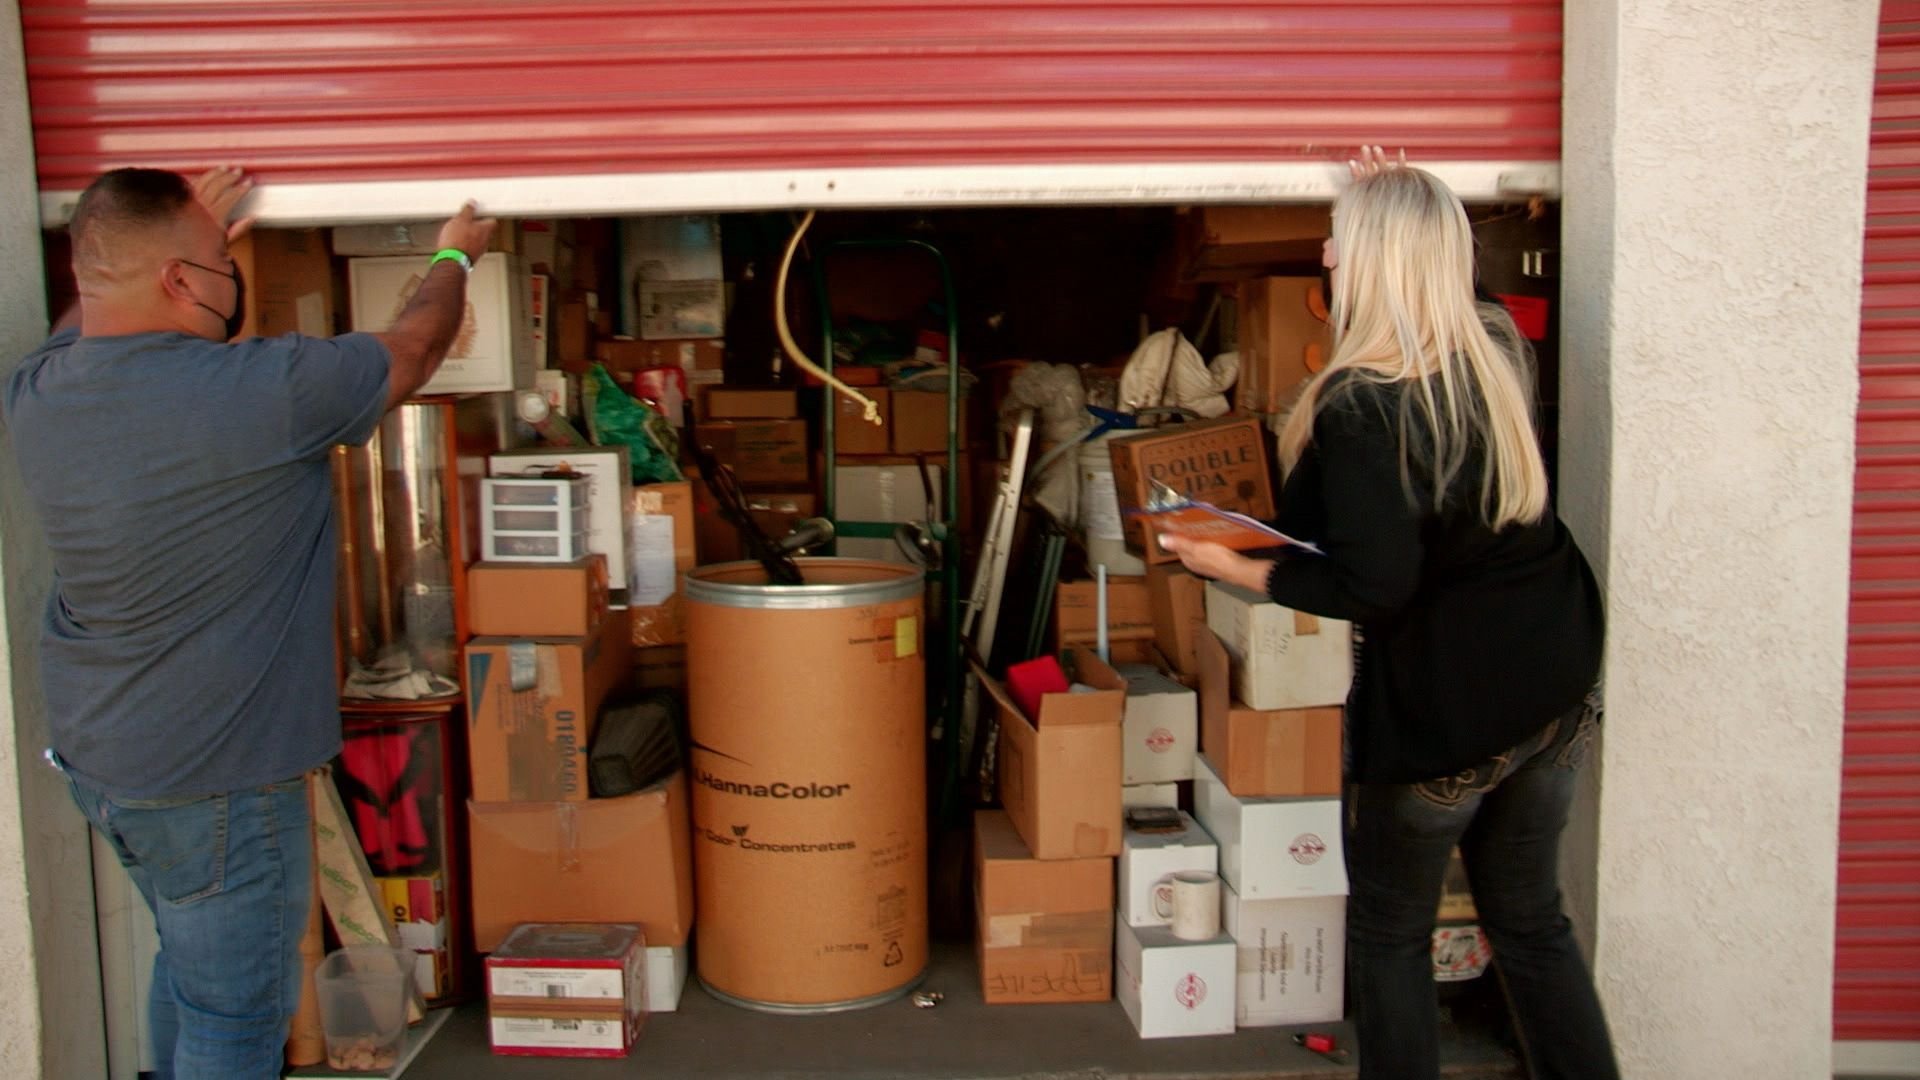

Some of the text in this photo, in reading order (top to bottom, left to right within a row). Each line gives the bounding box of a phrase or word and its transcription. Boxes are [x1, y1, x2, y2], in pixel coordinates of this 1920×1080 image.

[1149, 443, 1256, 480] DOUBLE
[1185, 472, 1228, 495] IPA
[705, 828, 737, 846] Color
[740, 838, 857, 853] Concentrates
